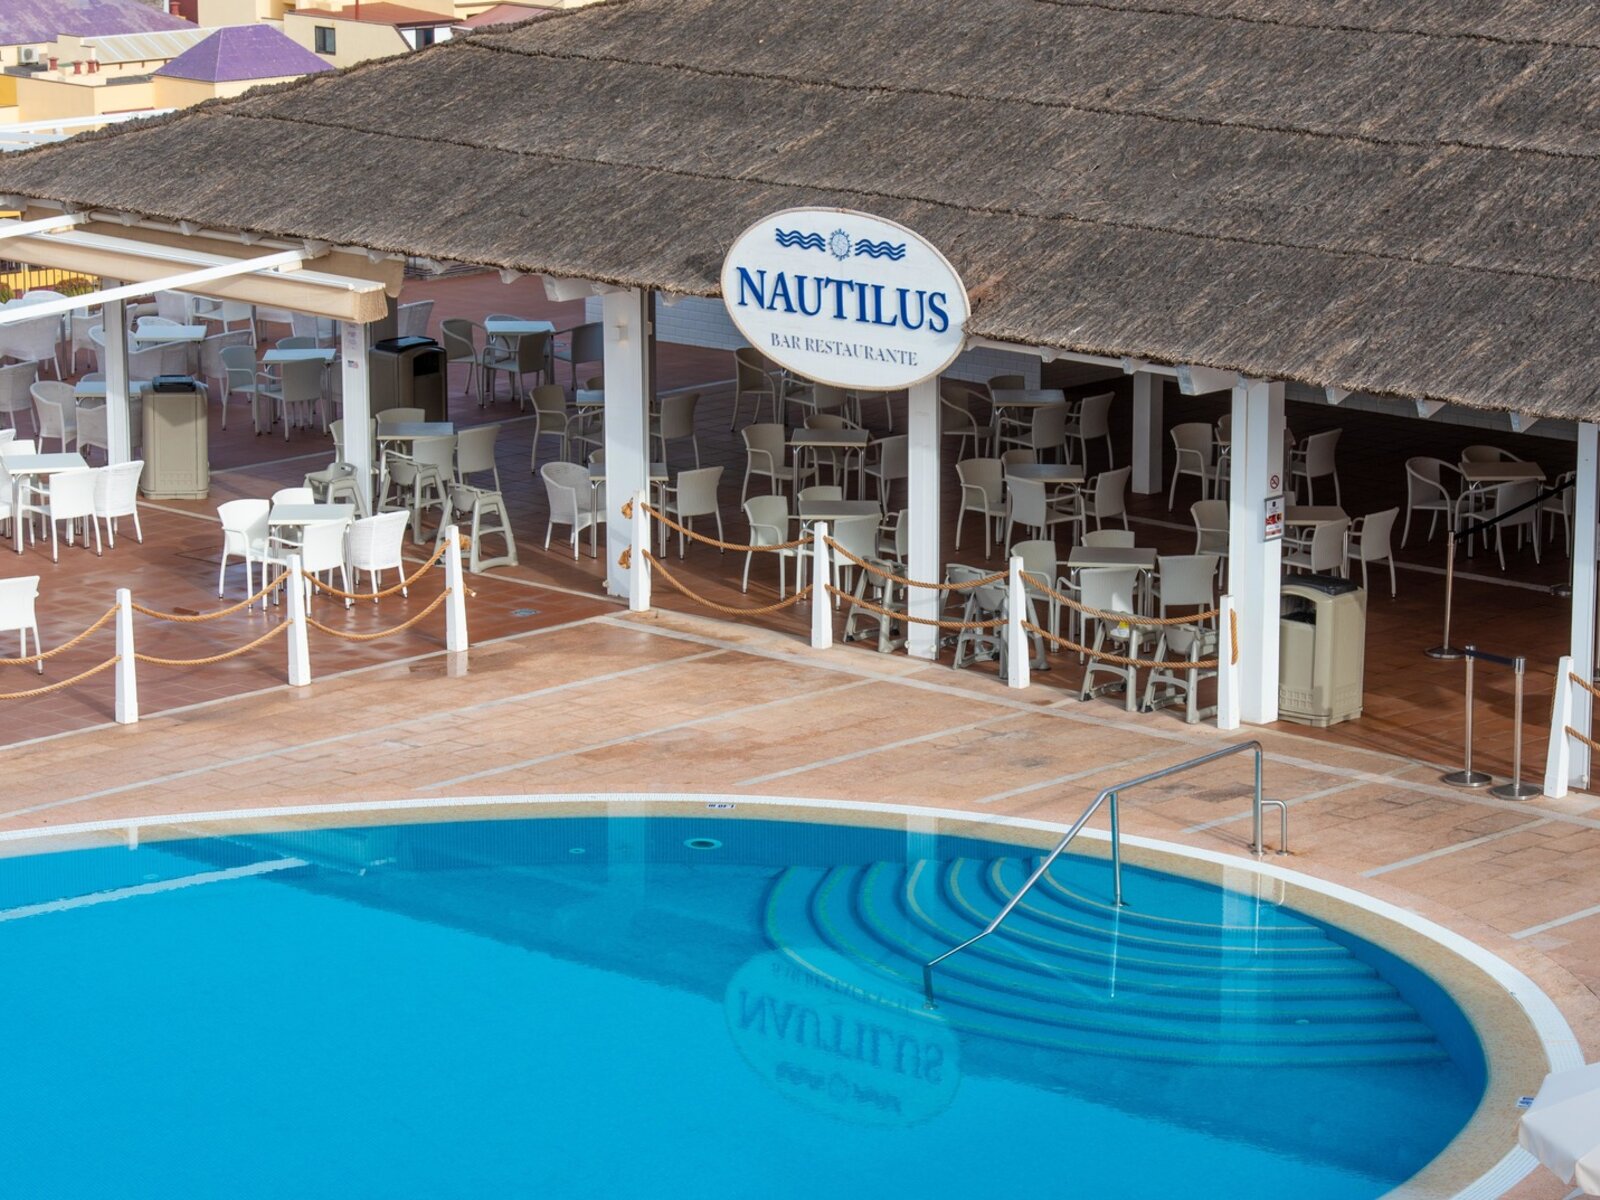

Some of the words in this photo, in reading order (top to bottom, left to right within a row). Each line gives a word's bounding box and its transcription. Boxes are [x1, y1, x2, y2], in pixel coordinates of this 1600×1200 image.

[736, 266, 949, 333] NAUTILUS
[771, 332, 801, 350] BAR
[805, 337, 918, 367] RESTAURANTE
